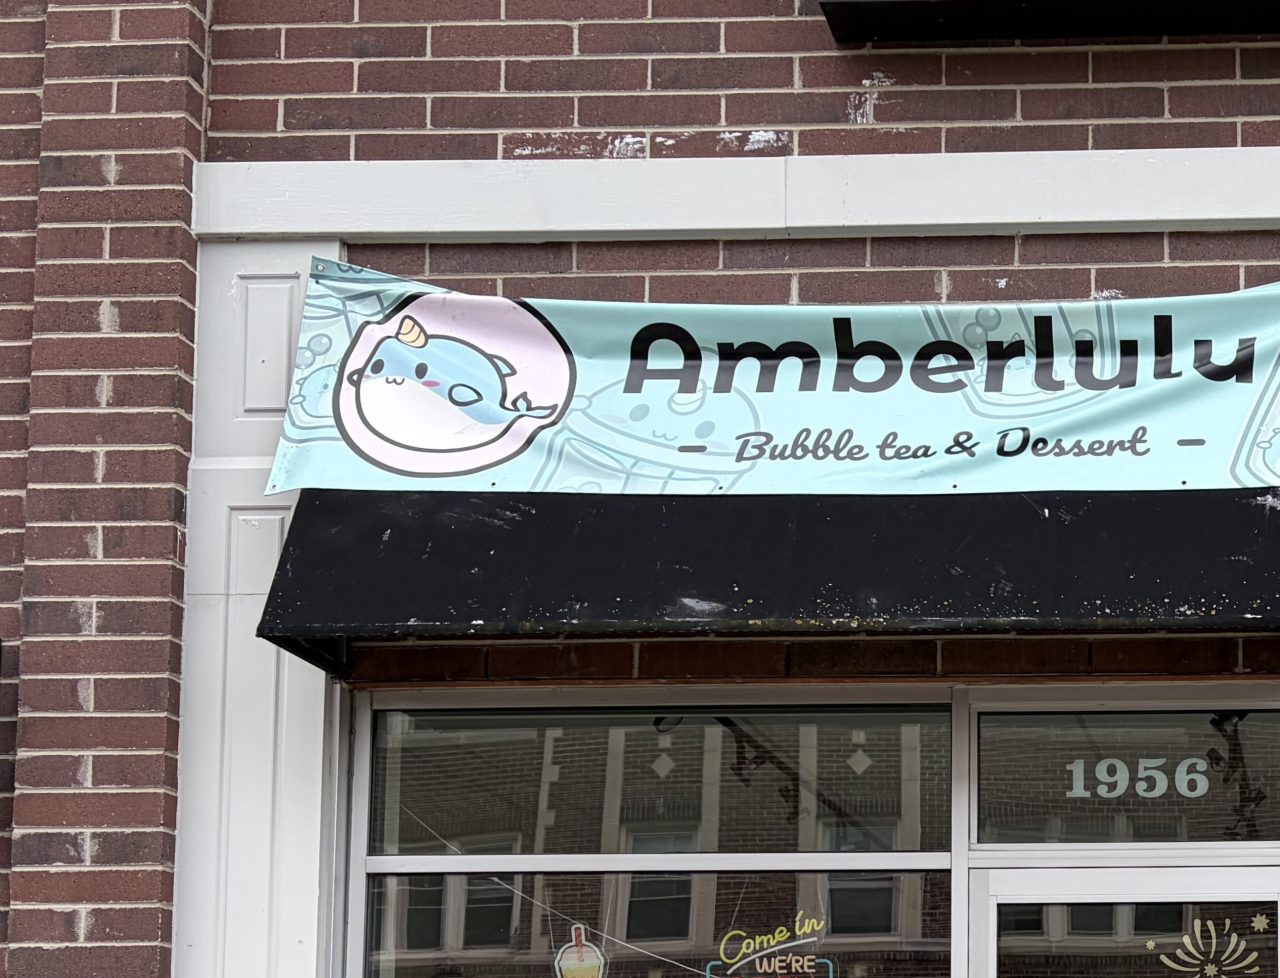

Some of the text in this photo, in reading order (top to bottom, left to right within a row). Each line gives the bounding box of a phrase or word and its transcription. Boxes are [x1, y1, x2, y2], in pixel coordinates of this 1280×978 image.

[622, 314, 1258, 395] Amberlulu
[734, 426, 1150, 464] Bubble tea & Dessert
[1065, 757, 1210, 799] 1956
[719, 910, 825, 964] Come in
[755, 955, 816, 974] WE'RE
